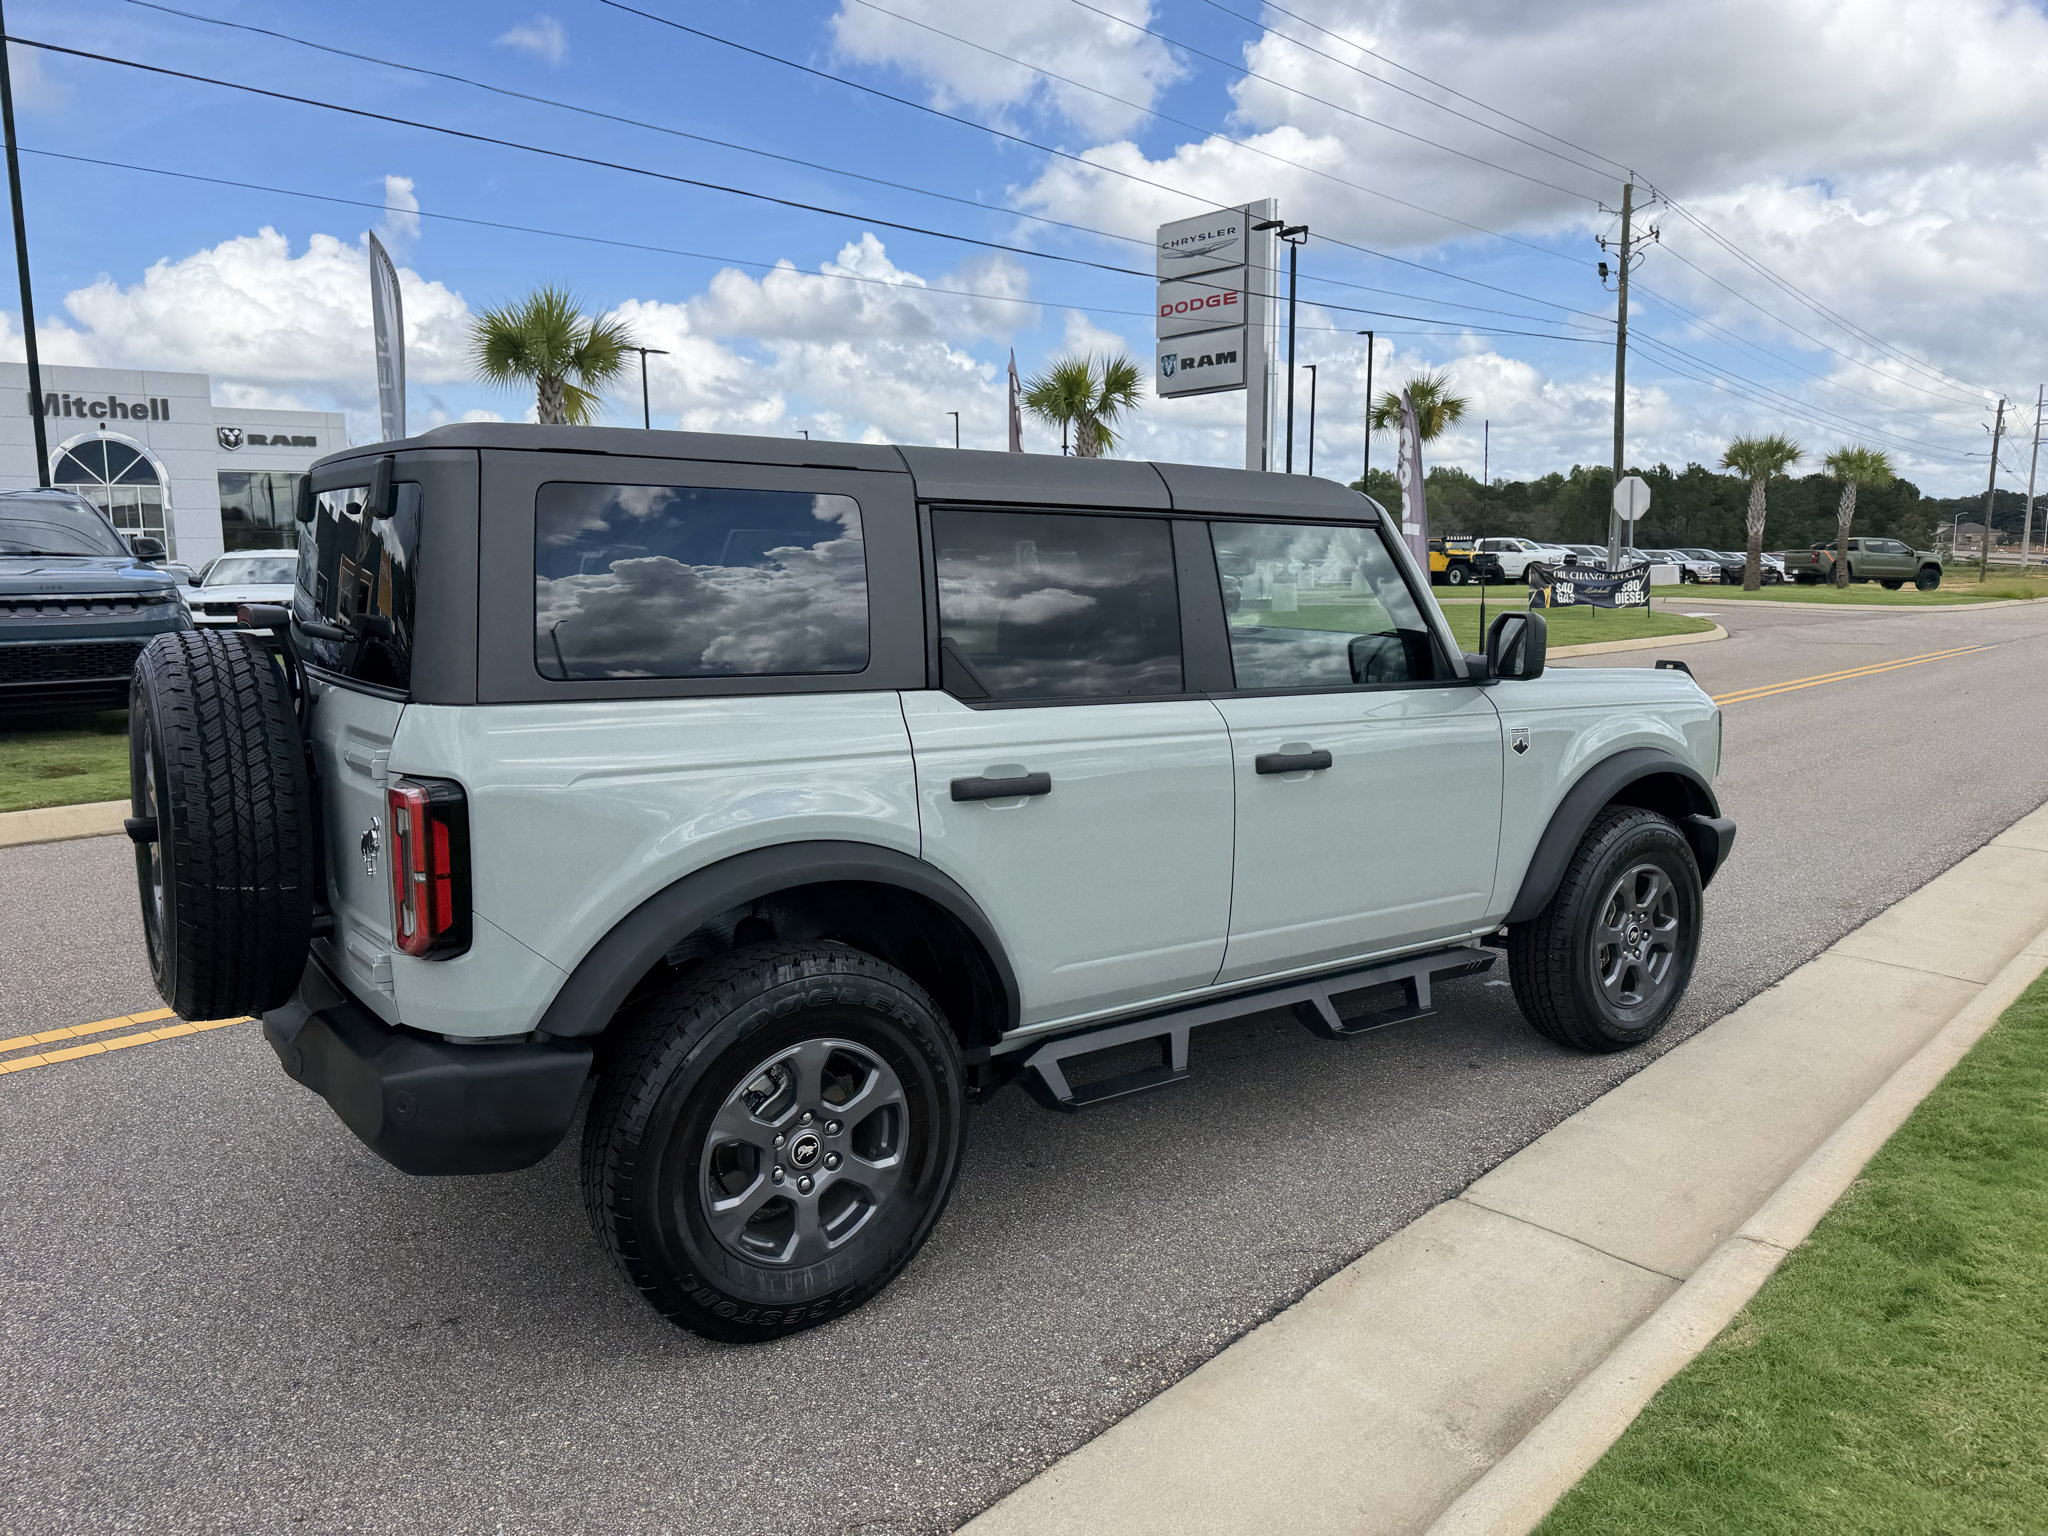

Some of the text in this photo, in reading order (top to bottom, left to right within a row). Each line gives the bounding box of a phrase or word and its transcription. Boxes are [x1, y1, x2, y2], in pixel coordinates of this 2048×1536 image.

[1162, 227, 1237, 249] CHRYSLER
[1160, 291, 1238, 317] DODGE
[1180, 351, 1237, 371] RAM
[247, 434, 317, 447] RAM
[1553, 570, 1569, 579] OIL
[1569, 571, 1607, 580] CHANGE
[1556, 582, 1574, 594] $40
[1557, 593, 1576, 604] GAS
[1615, 591, 1646, 605] DIESEL
